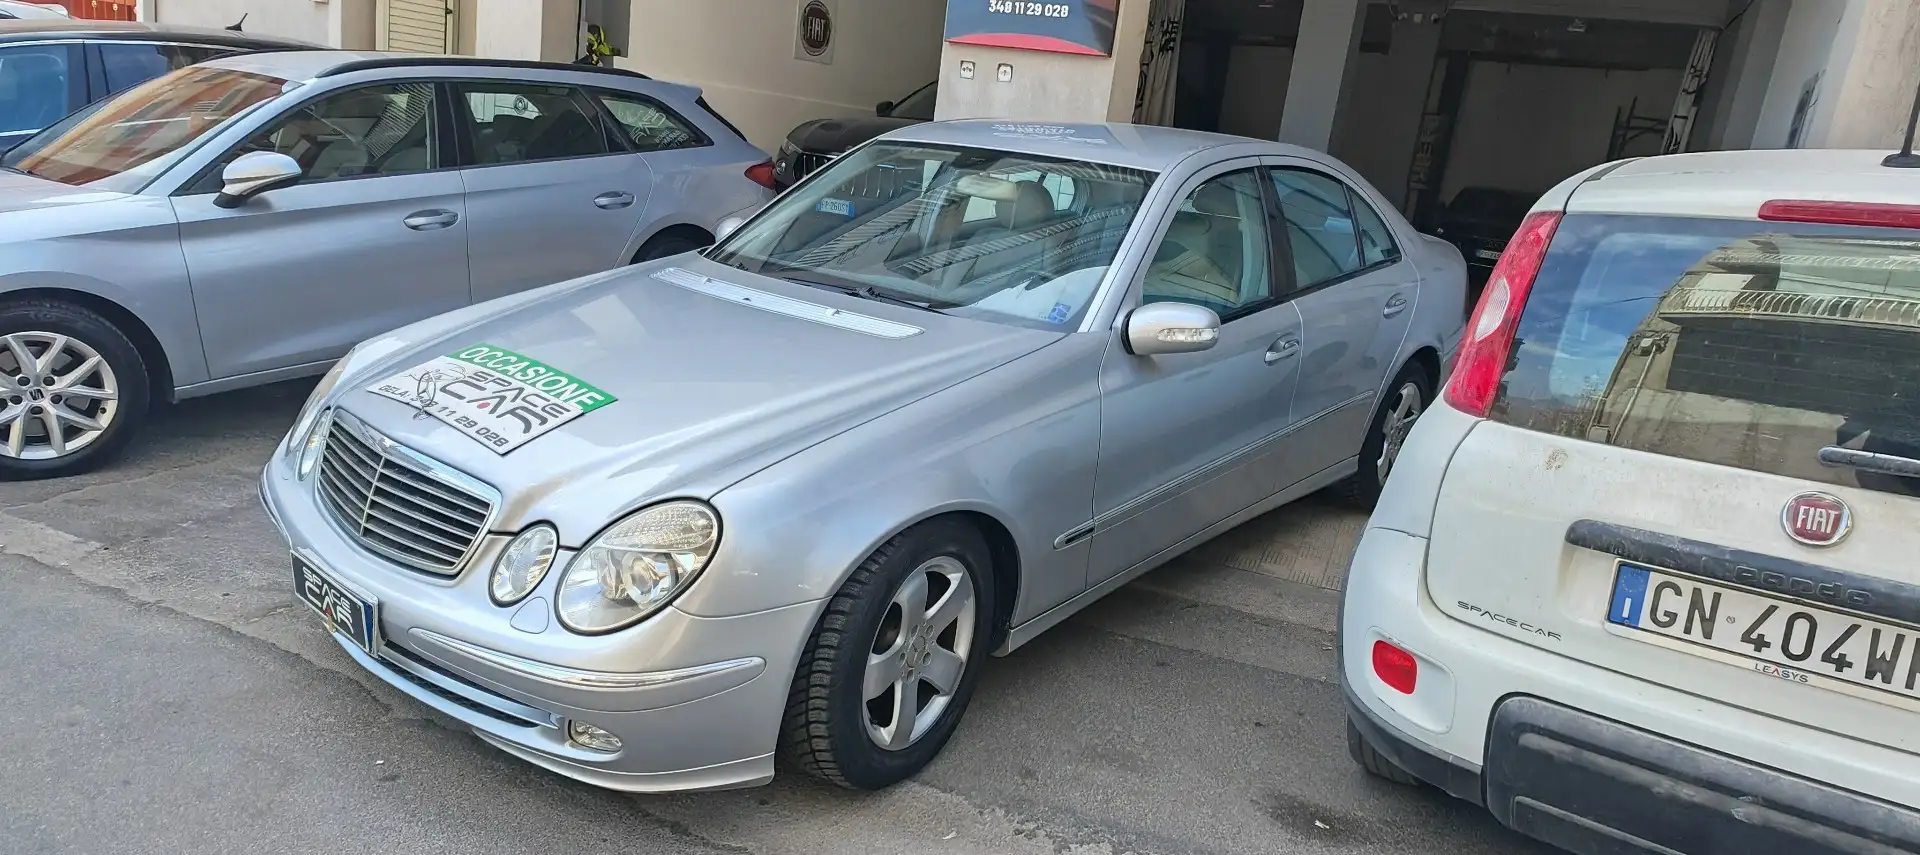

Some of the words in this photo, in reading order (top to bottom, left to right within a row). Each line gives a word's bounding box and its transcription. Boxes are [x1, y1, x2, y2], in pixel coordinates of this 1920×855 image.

[808, 17, 825, 42] FIAT
[988, 0, 1013, 14] 348
[1014, 2, 1025, 15] 11
[1026, 2, 1042, 16] 29
[1044, 4, 1069, 18] 028
[460, 346, 605, 408] OCCASIONE
[466, 370, 572, 419] SPACE
[437, 406, 458, 418] 11
[454, 415, 479, 429] 29
[475, 427, 510, 448] 028
[439, 379, 549, 434] CAR
[1796, 505, 1840, 534] FIAT
[302, 566, 352, 614] SPACE
[305, 580, 354, 634] CAR
[1649, 580, 1722, 640] GN
[1754, 663, 1809, 683] LEASYS
